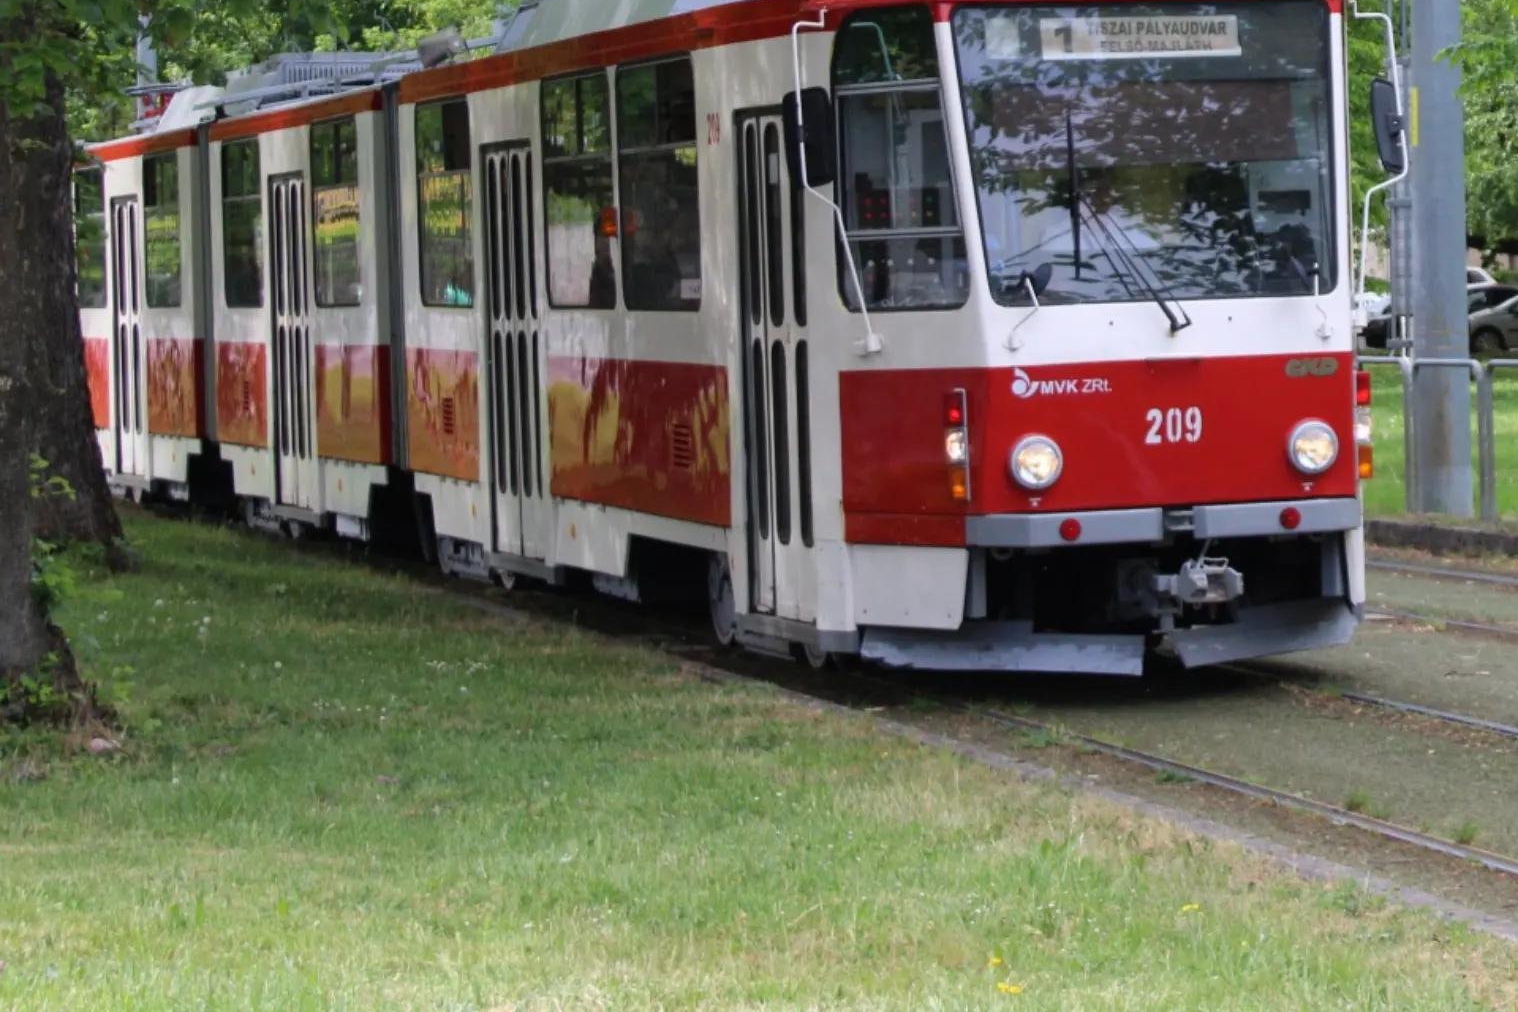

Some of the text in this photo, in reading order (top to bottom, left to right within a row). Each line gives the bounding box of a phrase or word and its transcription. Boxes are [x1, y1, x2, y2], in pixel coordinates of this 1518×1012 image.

[1054, 24, 1072, 52] 1
[1041, 379, 1079, 395] MVK
[1145, 406, 1202, 444] 209
